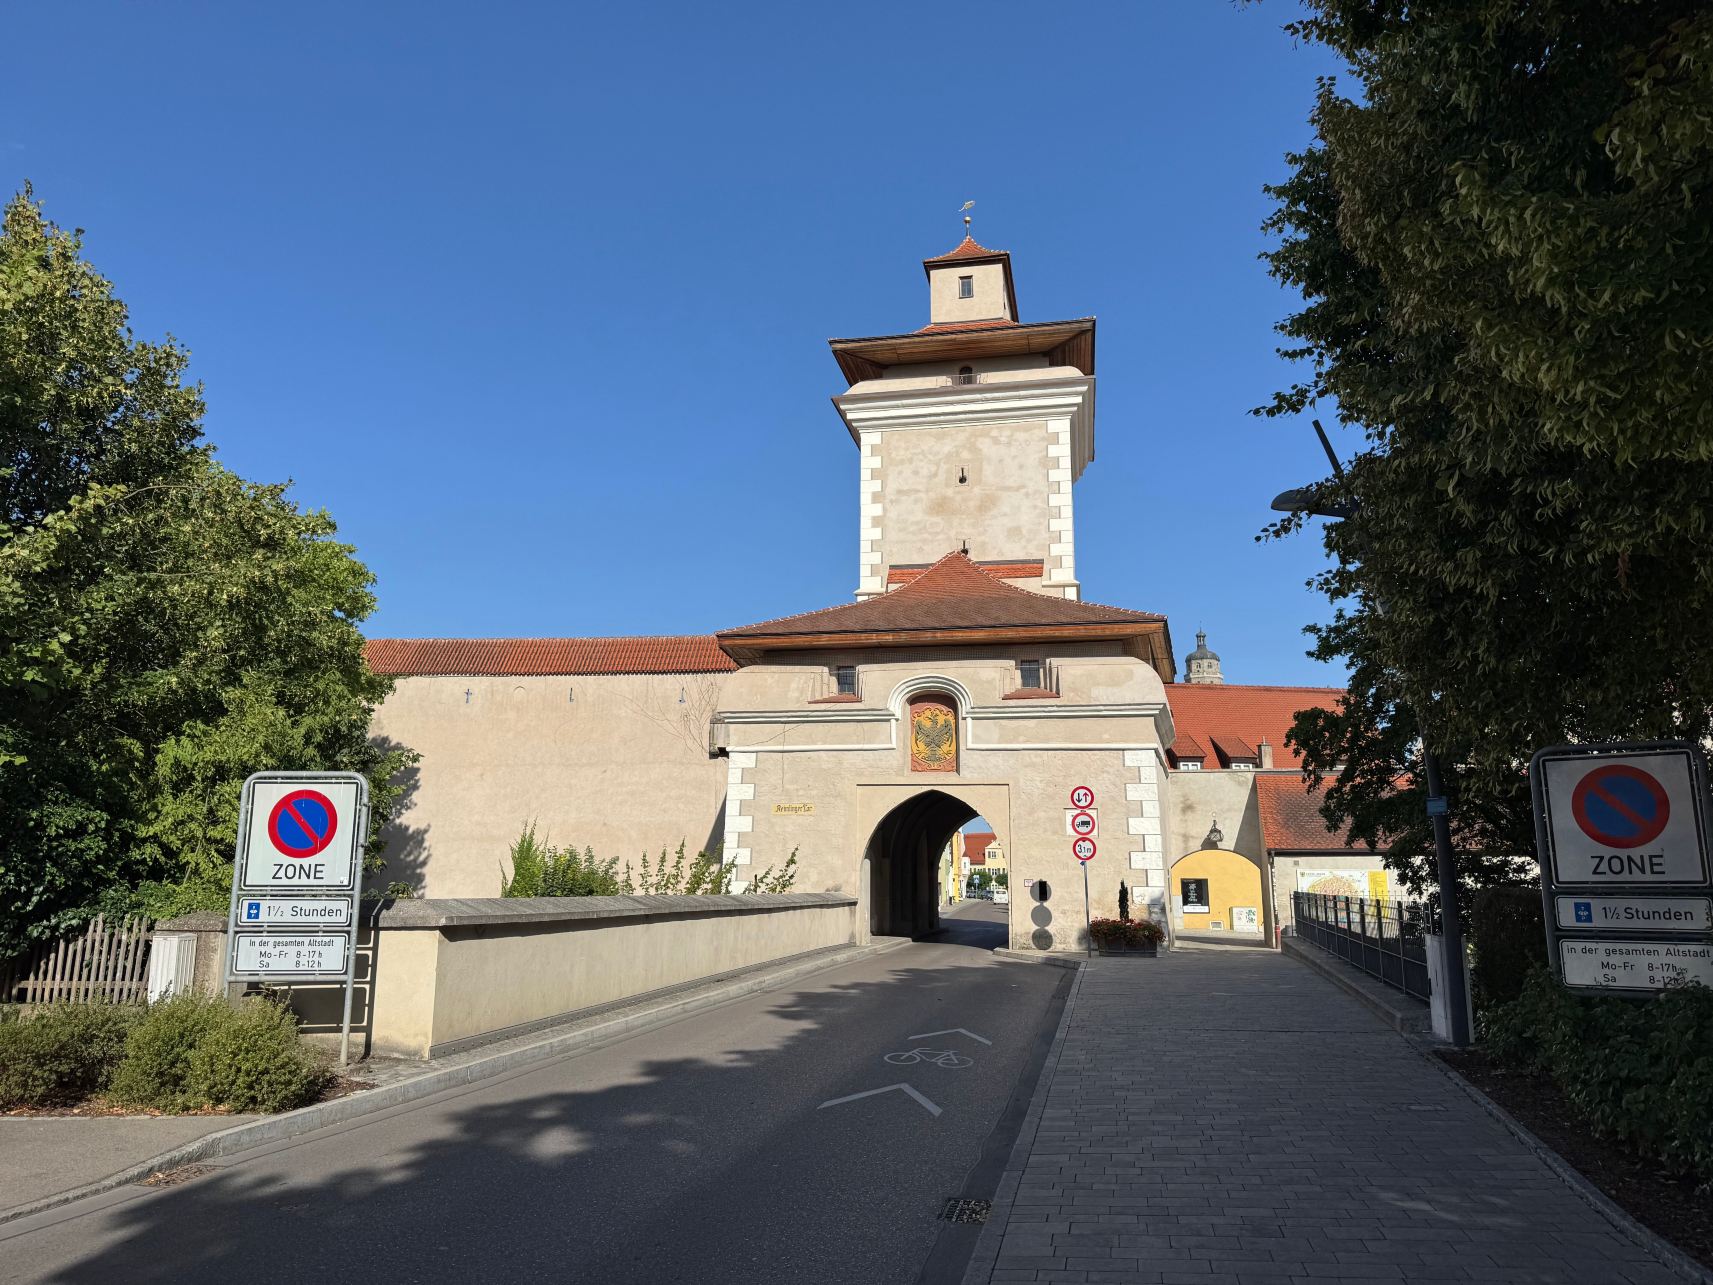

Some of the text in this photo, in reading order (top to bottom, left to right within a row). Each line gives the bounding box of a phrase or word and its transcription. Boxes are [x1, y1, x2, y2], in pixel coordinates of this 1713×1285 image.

[1590, 854, 1666, 876] ZONE
[272, 863, 325, 880] ZONE
[290, 906, 342, 917] Stunden
[1624, 906, 1694, 921] Stunden
[258, 939, 270, 947] der
[272, 940, 305, 949] gesamten
[307, 939, 334, 947] Altstadt
[1566, 945, 1711, 958] in der gesamten Altstadt
[258, 960, 270, 969] Sa
[1601, 961, 1635, 971] Mo-Fr
[1603, 974, 1617, 983] Sa
